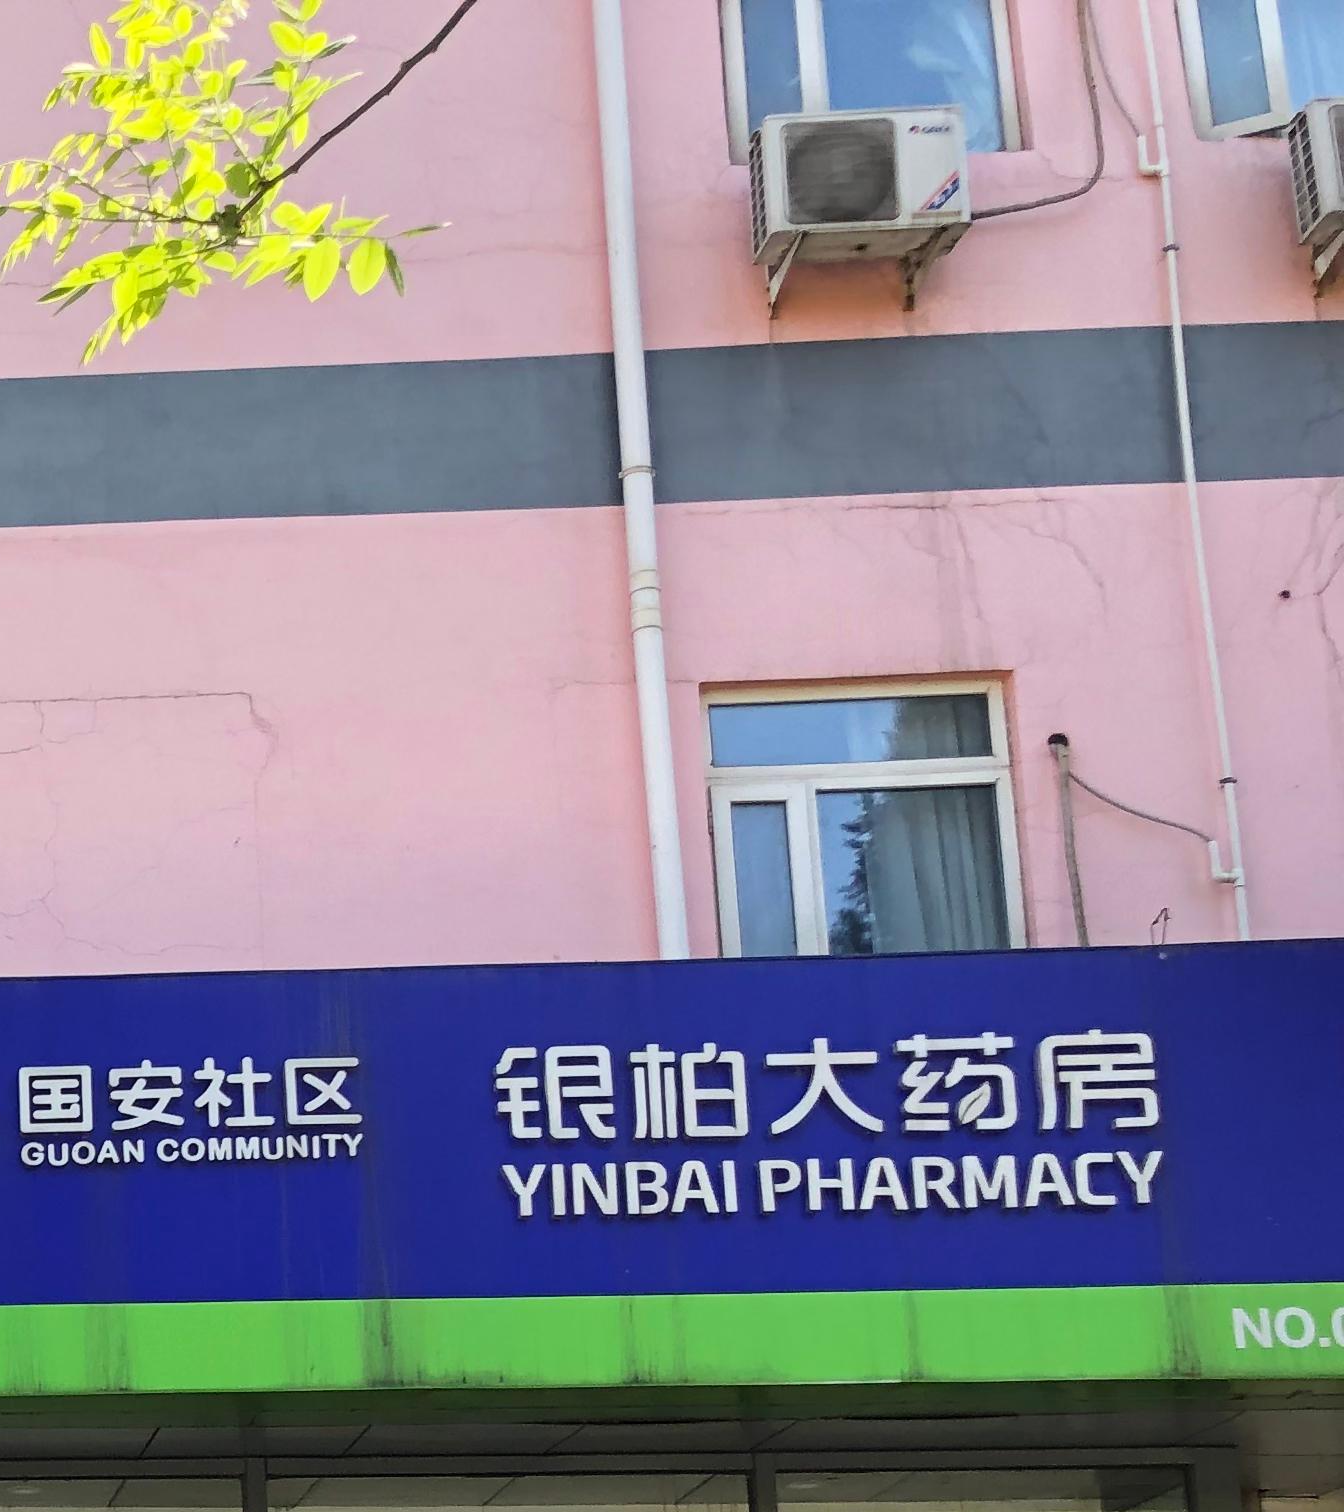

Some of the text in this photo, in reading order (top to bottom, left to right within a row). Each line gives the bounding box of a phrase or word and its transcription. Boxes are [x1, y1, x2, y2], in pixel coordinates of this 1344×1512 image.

[18, 1056, 362, 1133] 国安社区
[494, 1029, 1161, 1140] 银柏大药房
[20, 1132, 363, 1168] GUOAN COMMUNITY
[502, 1149, 1164, 1217] YINBAI PHARMACY
[1232, 1306, 1344, 1349] NO.
